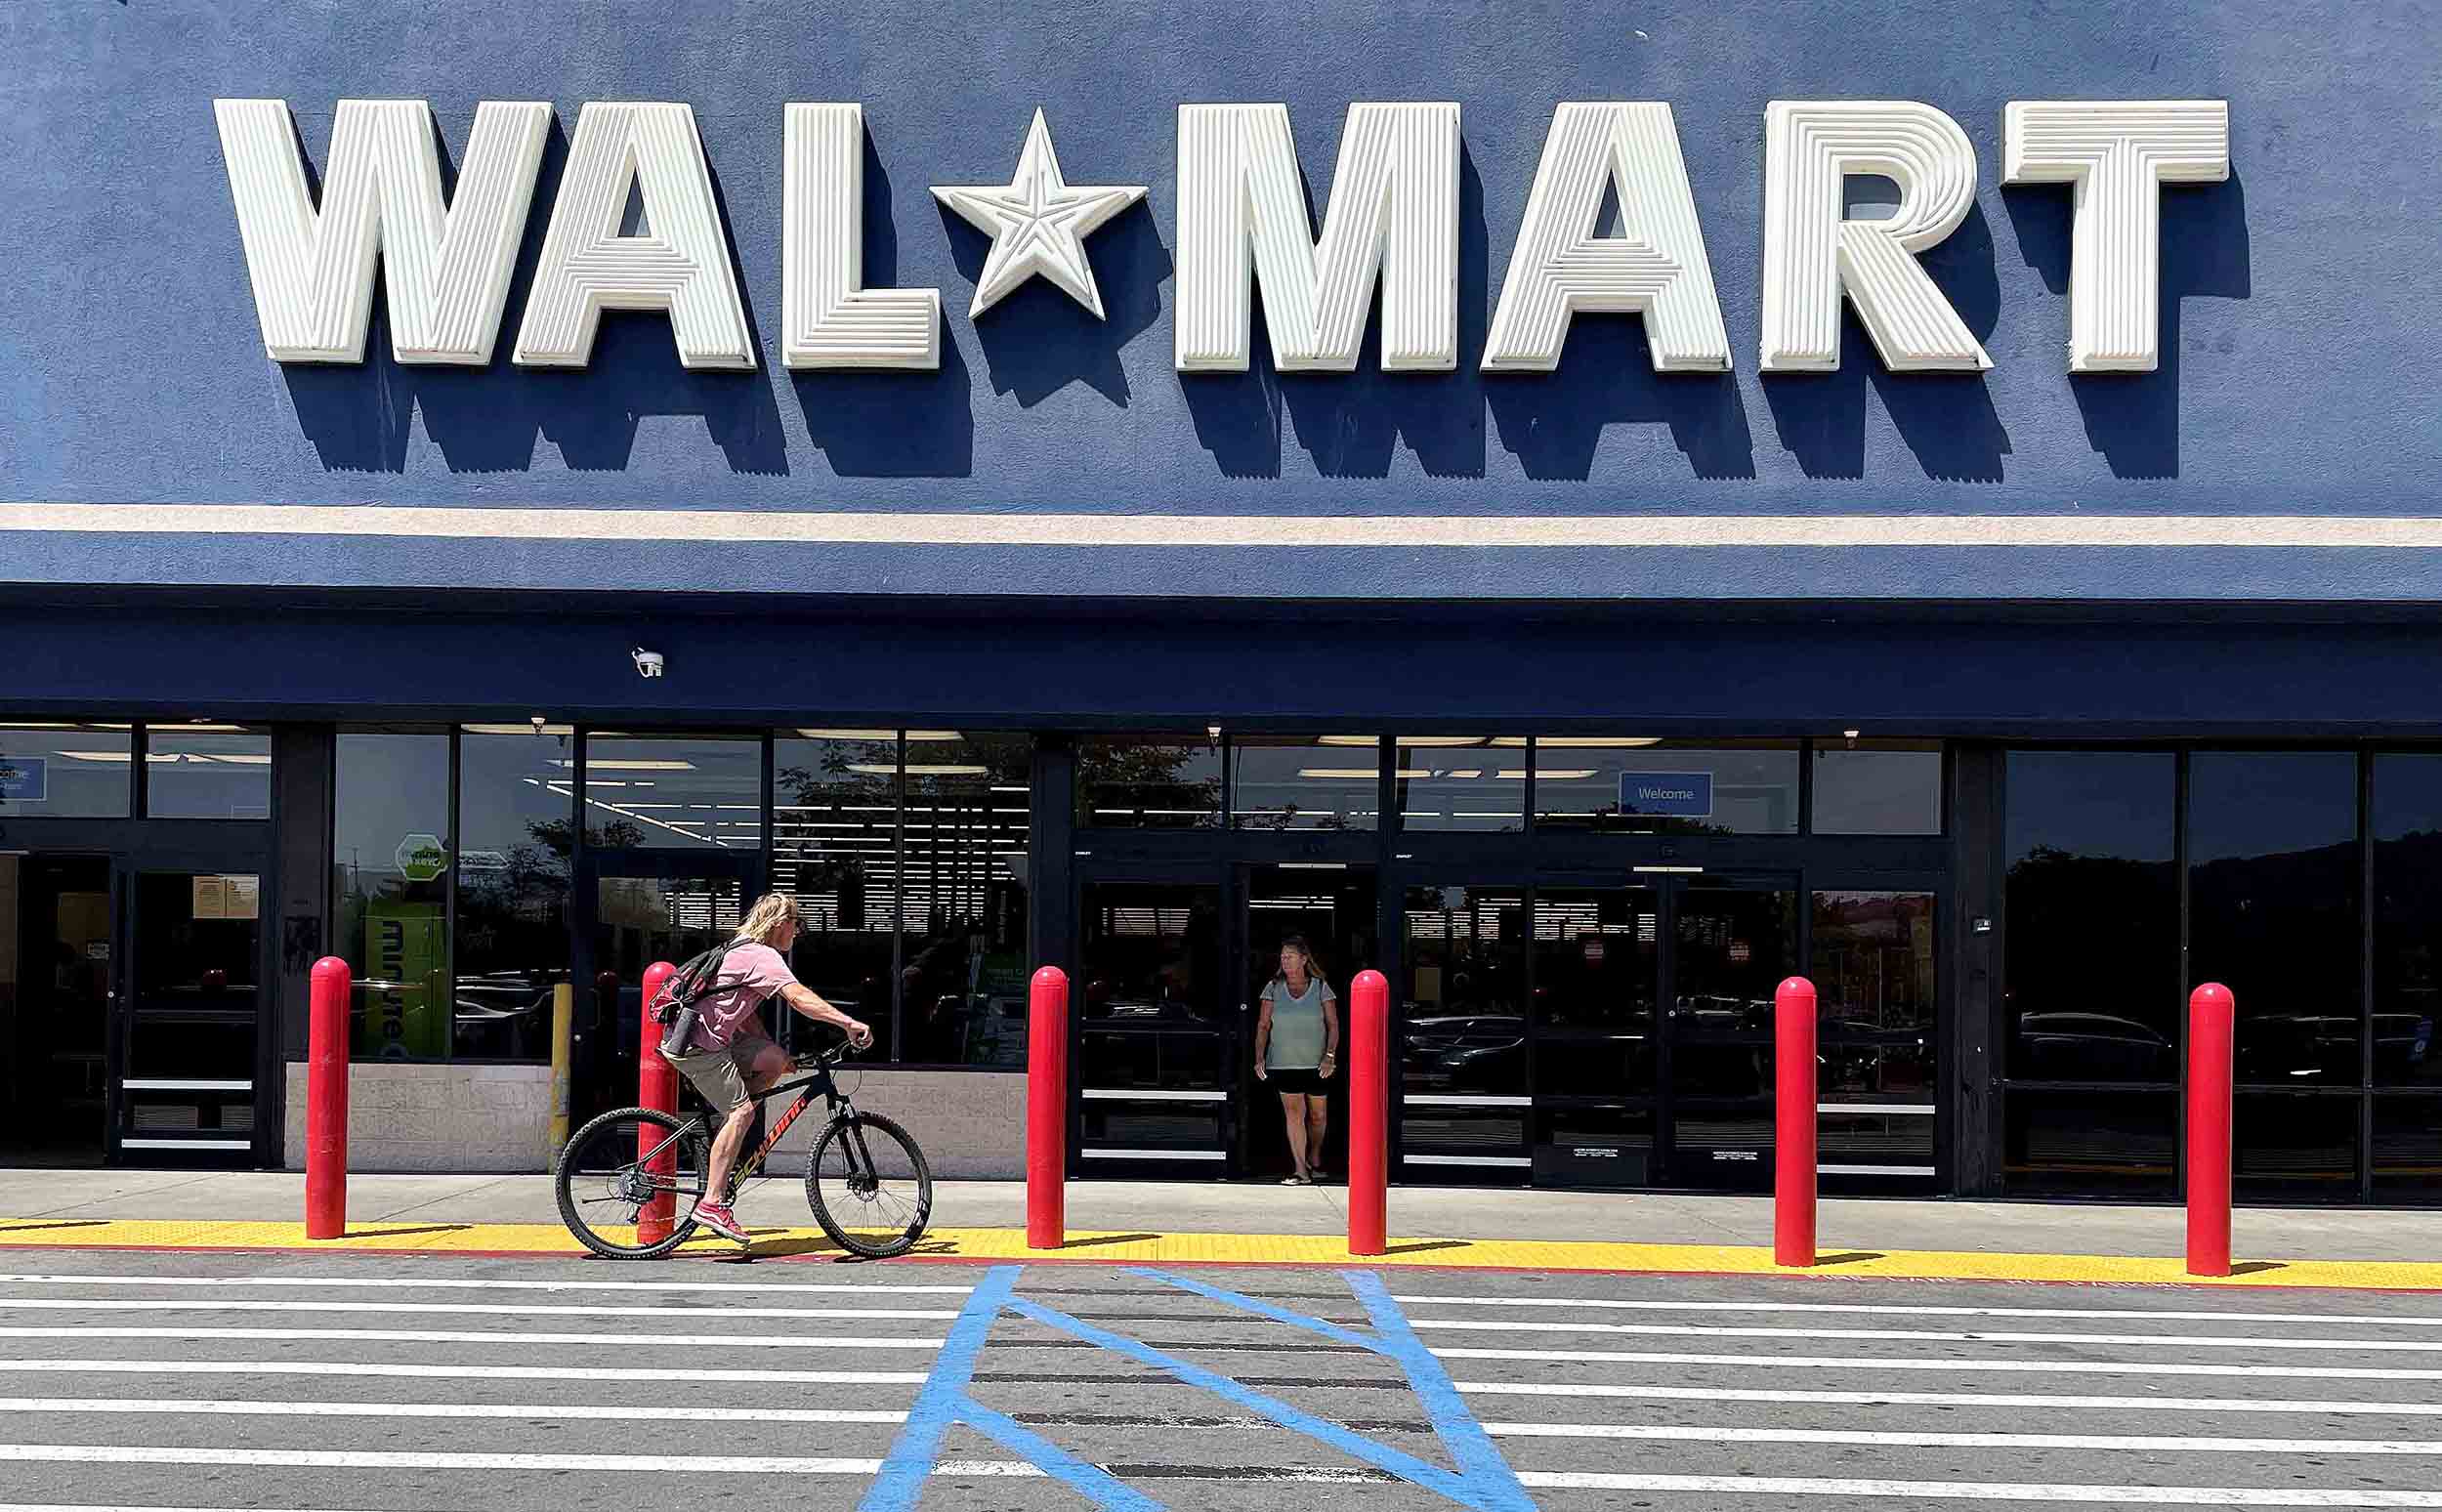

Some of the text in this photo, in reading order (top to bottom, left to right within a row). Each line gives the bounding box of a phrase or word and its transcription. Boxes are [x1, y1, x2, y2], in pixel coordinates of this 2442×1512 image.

[212, 98, 2231, 374] WAL MART
[1638, 787, 1696, 799] Welcome
